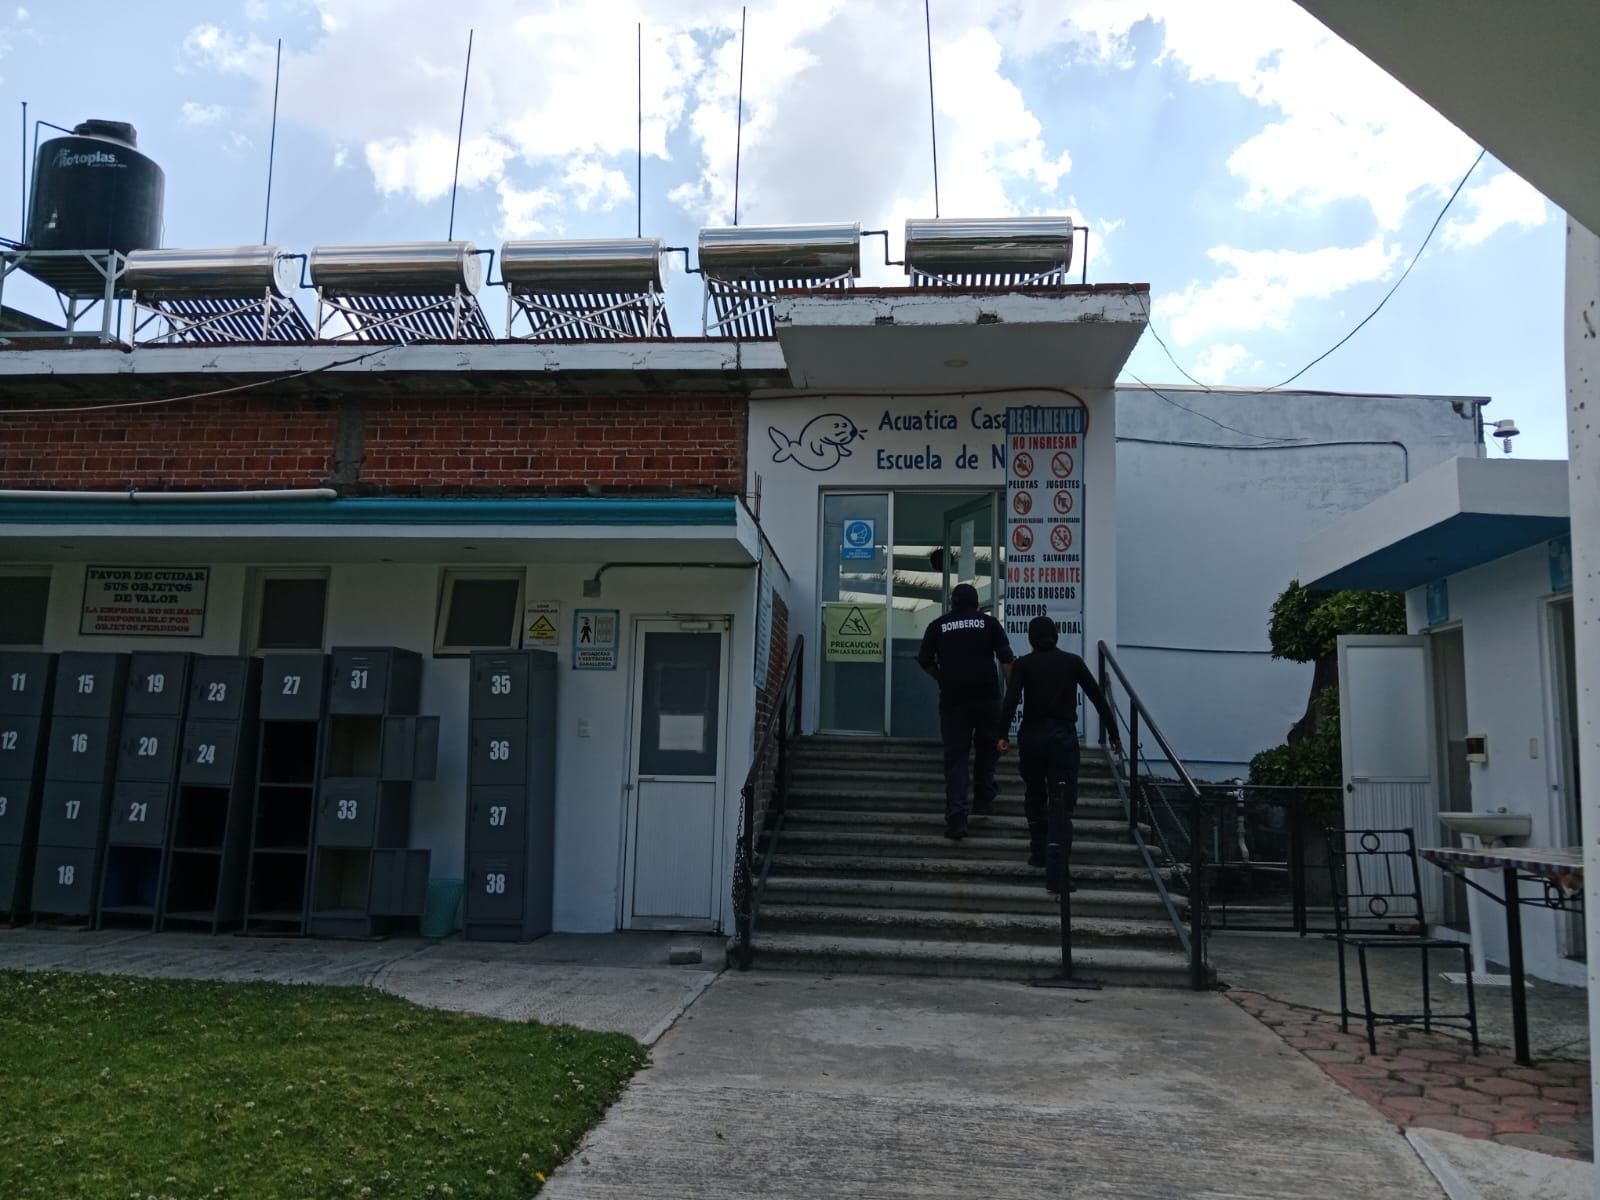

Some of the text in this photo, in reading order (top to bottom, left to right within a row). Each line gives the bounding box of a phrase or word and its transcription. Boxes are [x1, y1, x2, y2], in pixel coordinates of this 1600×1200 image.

[879, 410, 958, 431] Acuatica
[1009, 408, 1081, 433] REGLAMENTO
[1013, 436, 1077, 449] NO INGRESAR
[877, 445, 942, 469] Escuela
[956, 444, 978, 469] de
[1008, 480, 1080, 489] PELOTAS JUGUETES
[1009, 554, 1079, 562] MALETAS SALVAVIDAS
[90, 570, 205, 581] FAVOR DE CUIDAR
[1008, 567, 1080, 583] NO SE PERMITE
[104, 582, 193, 592] SUS OBJETOS
[1007, 587, 1075, 599] JUEGOS BRUSCOS
[113, 594, 179, 603] DE VALOR
[96, 615, 189, 624] RESPONSABLE POR
[1006, 604, 1047, 616] CLAVADOS
[95, 623, 190, 632] OBJETOS PERDIDOS
[941, 619, 985, 633] BOMBEROS
[11, 672, 27, 692] 11
[77, 674, 95, 694] 15
[146, 673, 165, 693] 19
[282, 675, 301, 695] 27
[350, 669, 368, 690] 31
[491, 674, 512, 695] 35
[207, 682, 226, 702] 23
[1, 731, 18, 750] 12
[71, 733, 88, 753] 16
[138, 736, 158, 756] 20
[489, 740, 510, 761] 36
[196, 744, 216, 764] 24
[65, 800, 81, 820] 17
[128, 802, 147, 822] 21
[337, 799, 358, 820] 33
[489, 806, 507, 826] 37
[57, 865, 75, 885] 18
[486, 873, 506, 895] 38
